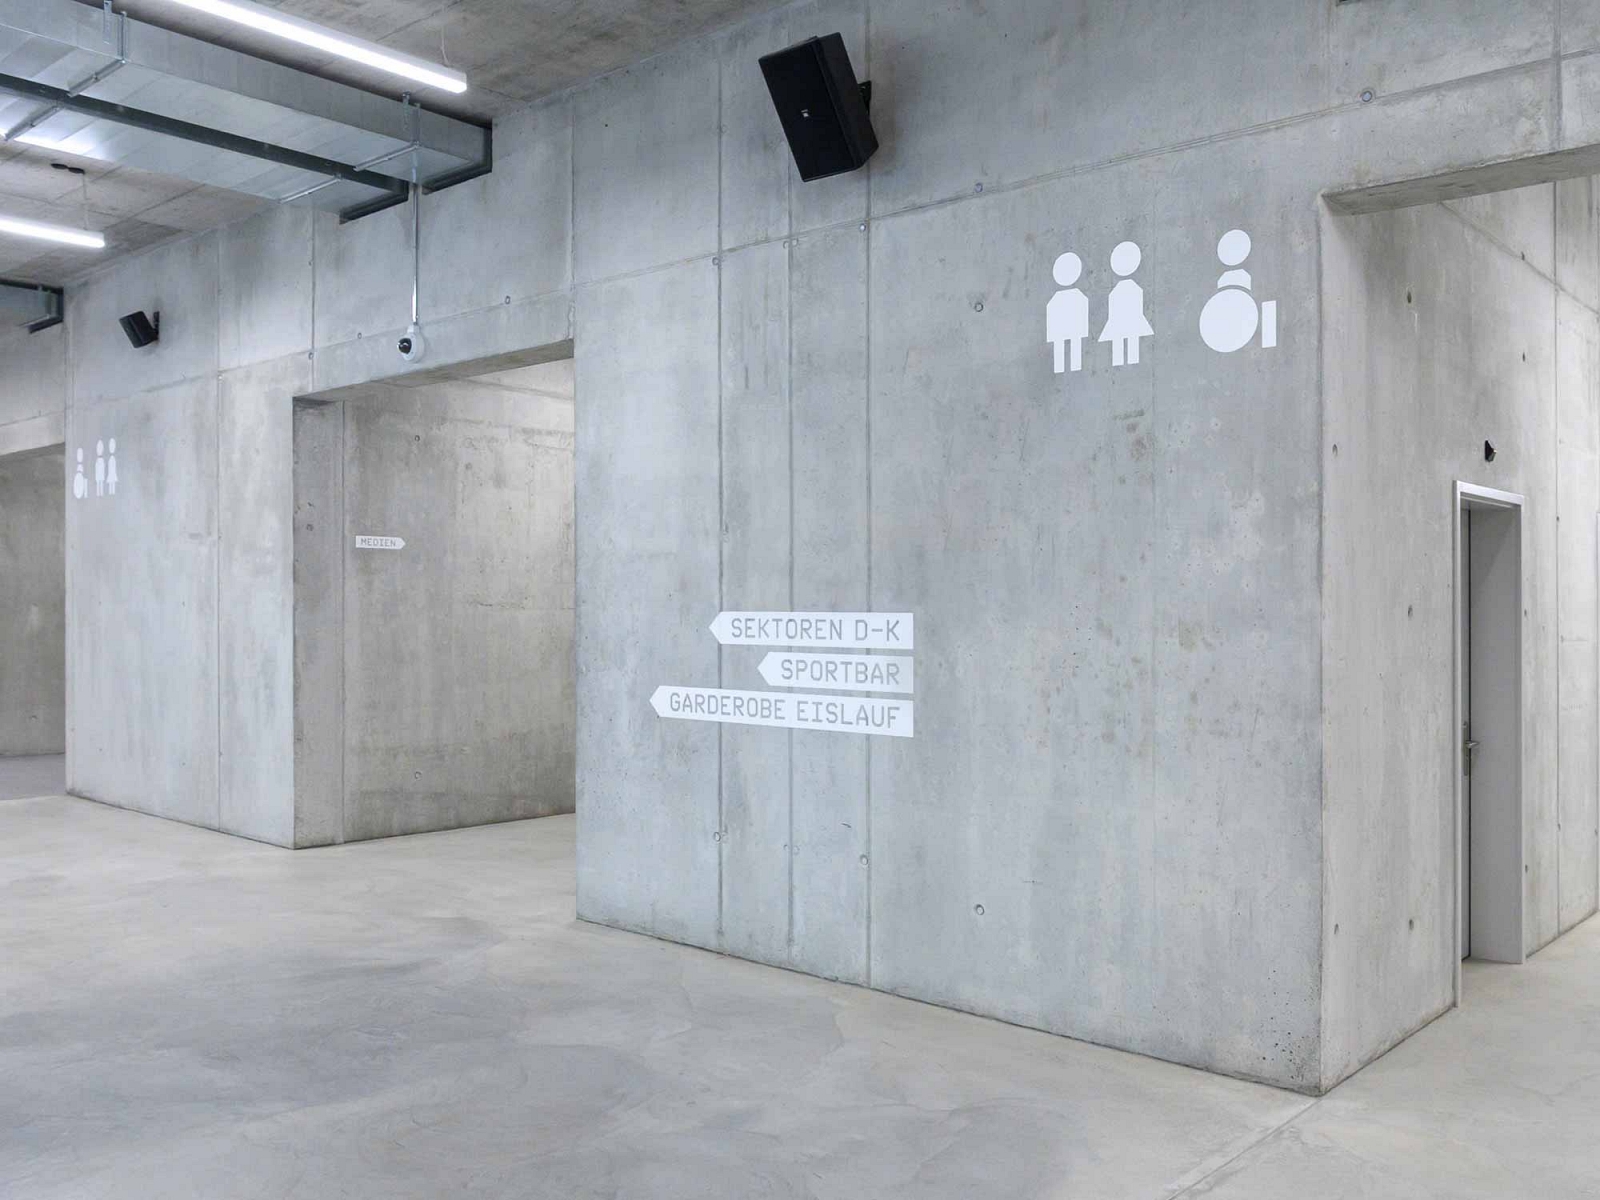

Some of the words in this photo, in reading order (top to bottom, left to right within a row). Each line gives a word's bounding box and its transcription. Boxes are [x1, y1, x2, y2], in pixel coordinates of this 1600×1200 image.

[360, 537, 396, 547] MEDIEN
[731, 618, 843, 640] SEKTOREN
[855, 619, 900, 642] D-K
[781, 659, 900, 685] SPORTBAR
[670, 692, 786, 720] GARDEROBE
[797, 700, 900, 729] EISLAUF
